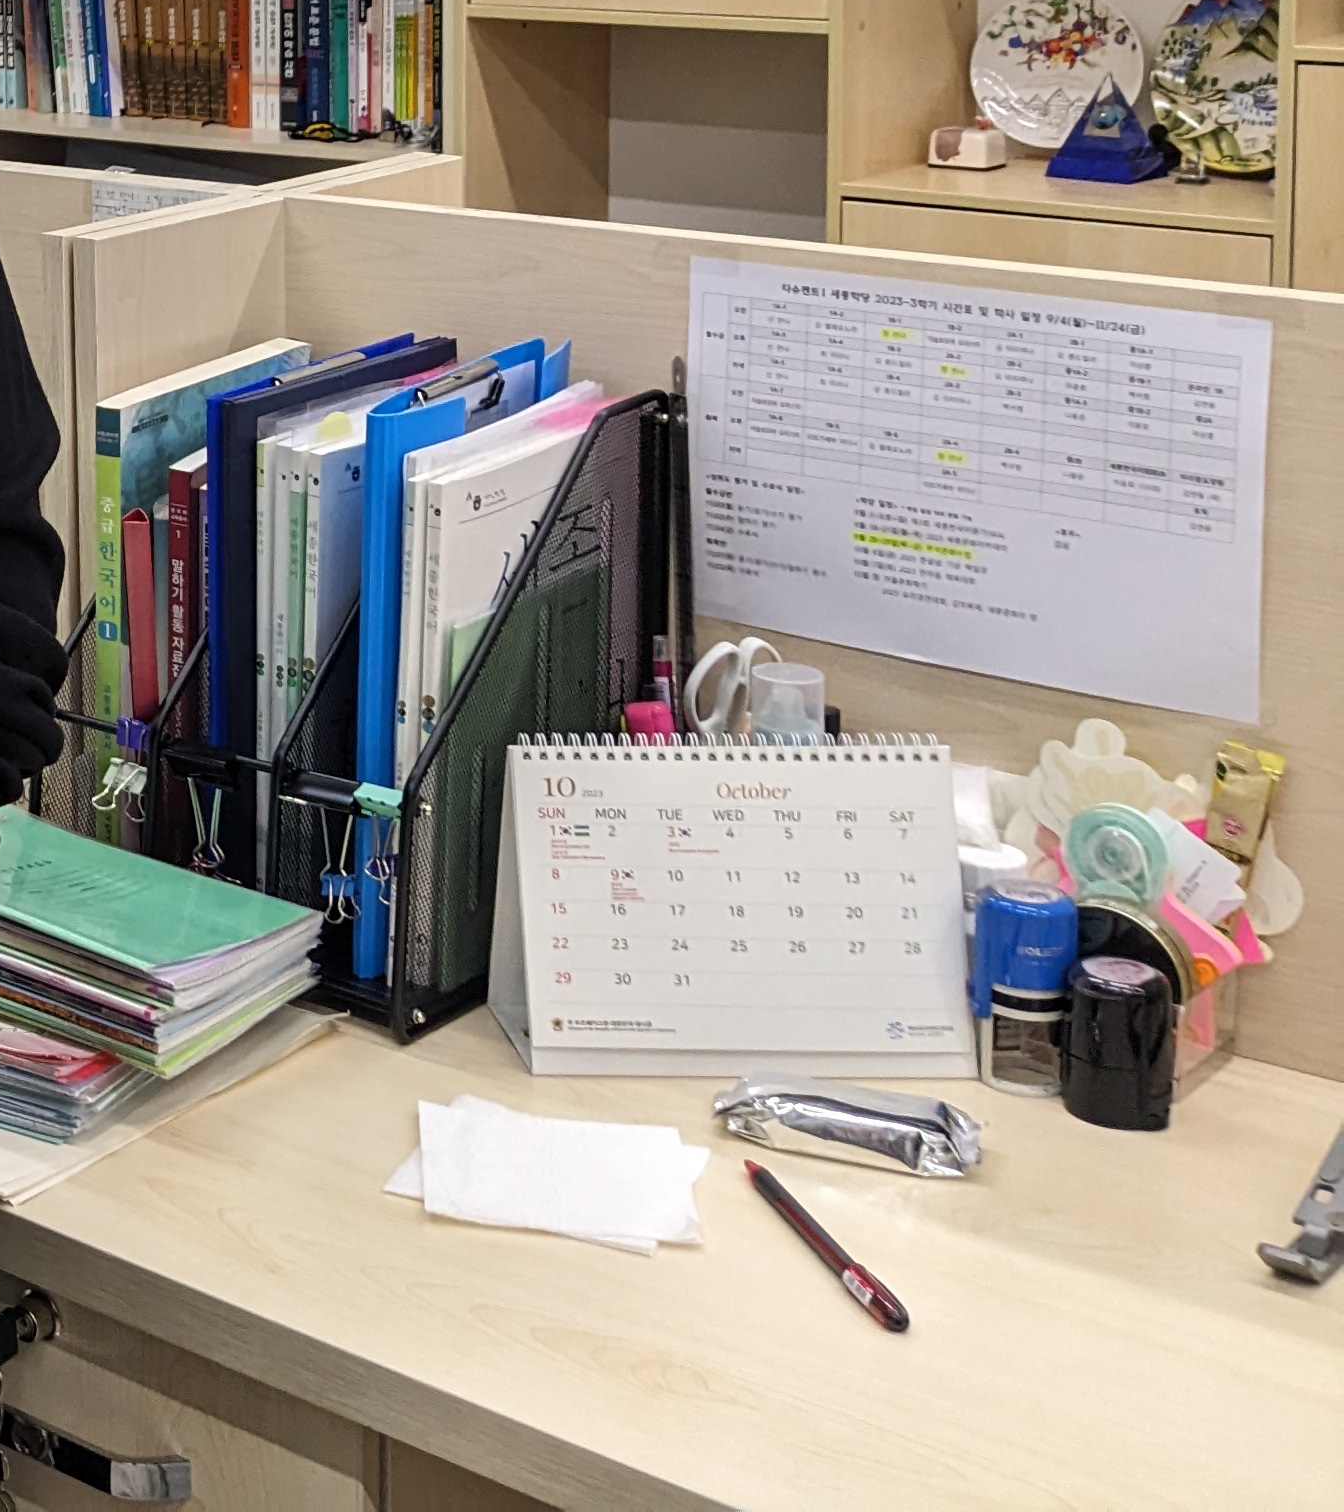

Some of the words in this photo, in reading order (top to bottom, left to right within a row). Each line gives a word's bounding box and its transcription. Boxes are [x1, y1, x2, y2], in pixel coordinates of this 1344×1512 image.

[100, 496, 116, 535] 중급
[99, 541, 118, 616] 한국어
[171, 558, 185, 602] 말하기
[171, 605, 185, 634] 활동
[543, 776, 576, 797] 10
[716, 781, 792, 800] October
[537, 807, 566, 820] SUN
[595, 807, 627, 820] MON
[657, 808, 682, 822] TUE
[712, 809, 745, 822] WED
[772, 809, 801, 823] THU
[835, 810, 858, 823] FRI
[889, 810, 915, 823] SAT
[549, 825, 558, 839] 1
[606, 825, 619, 839] 2
[667, 825, 676, 839] 3
[725, 827, 735, 839] 4
[784, 826, 794, 840] 5
[843, 827, 853, 840] 6
[898, 827, 908, 840] 7
[551, 868, 561, 880] 8
[610, 868, 621, 881] 9
[667, 869, 684, 882] 10
[726, 870, 741, 883] 11
[784, 870, 801, 884] 12
[844, 871, 861, 885] 13
[899, 872, 916, 885] 14
[551, 902, 567, 915] 15
[610, 903, 627, 916] 16
[669, 904, 686, 916] 17
[728, 905, 745, 918] 18
[787, 905, 804, 919] 19
[846, 906, 864, 920] 20
[901, 906, 918, 920] 21
[552, 936, 569, 950] 22
[611, 937, 629, 951] 23
[671, 938, 689, 951] 24
[730, 939, 748, 953] 25
[789, 940, 807, 954] 26
[848, 941, 866, 955] 27
[904, 941, 922, 955] 28
[555, 971, 572, 984] 29
[614, 972, 632, 986] 30
[674, 973, 690, 986] 31
